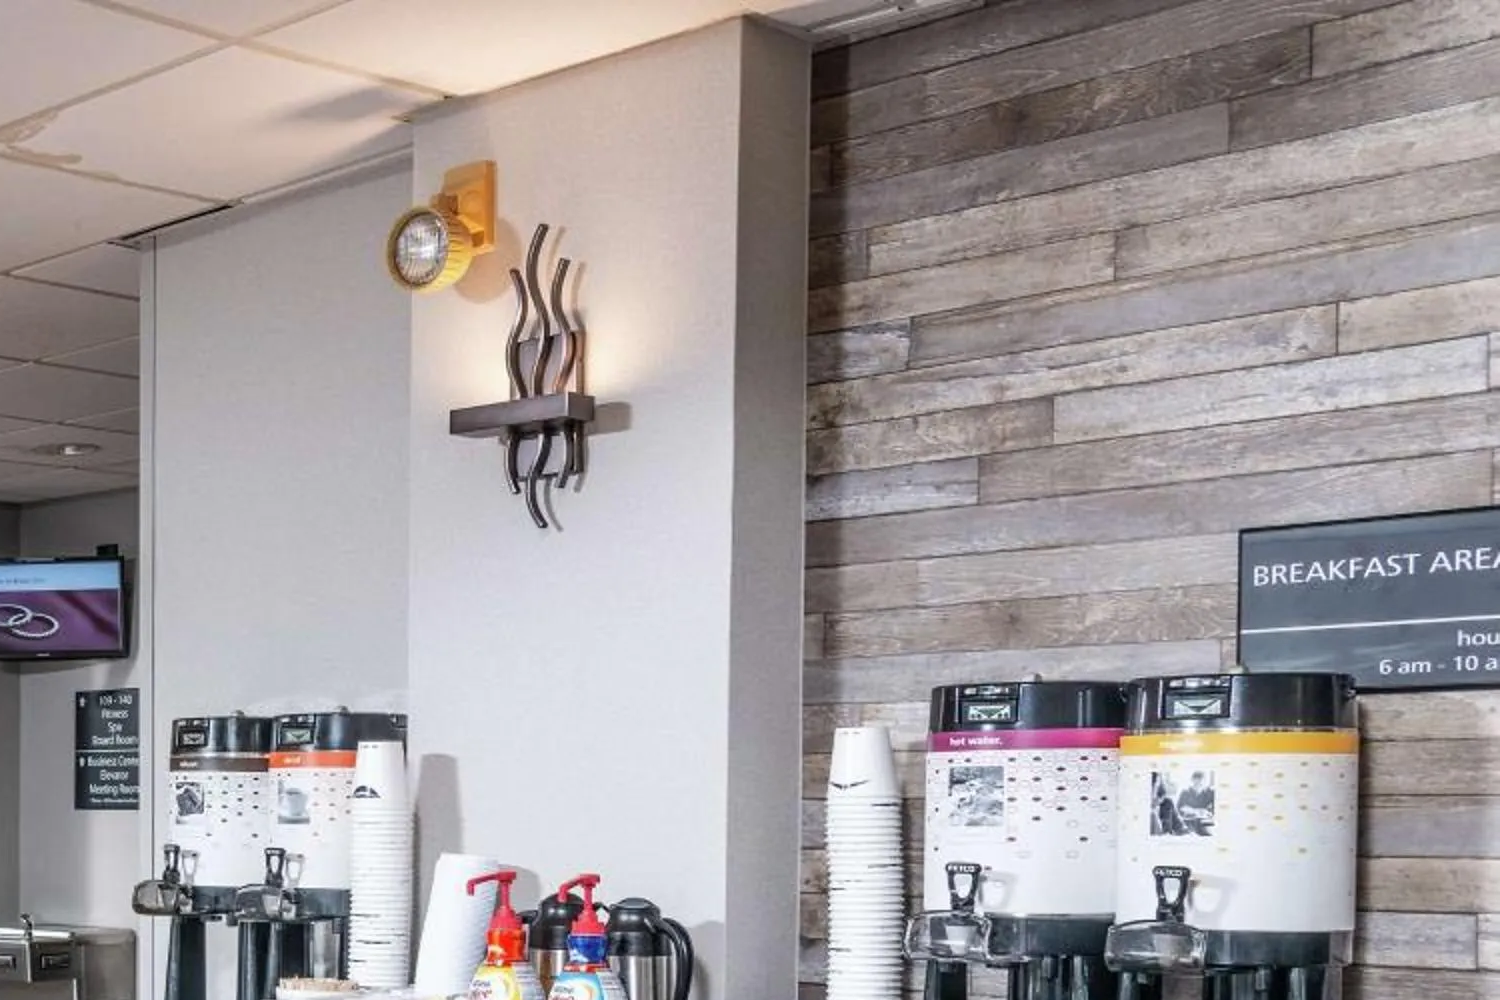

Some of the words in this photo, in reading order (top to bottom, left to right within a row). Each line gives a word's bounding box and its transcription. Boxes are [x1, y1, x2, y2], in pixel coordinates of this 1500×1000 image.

[1252, 553, 1422, 587] BREAKFAST
[1379, 659, 1393, 675] 6
[1398, 660, 1432, 674] am
[1453, 655, 1479, 672] 10
[948, 736, 966, 747] hot
